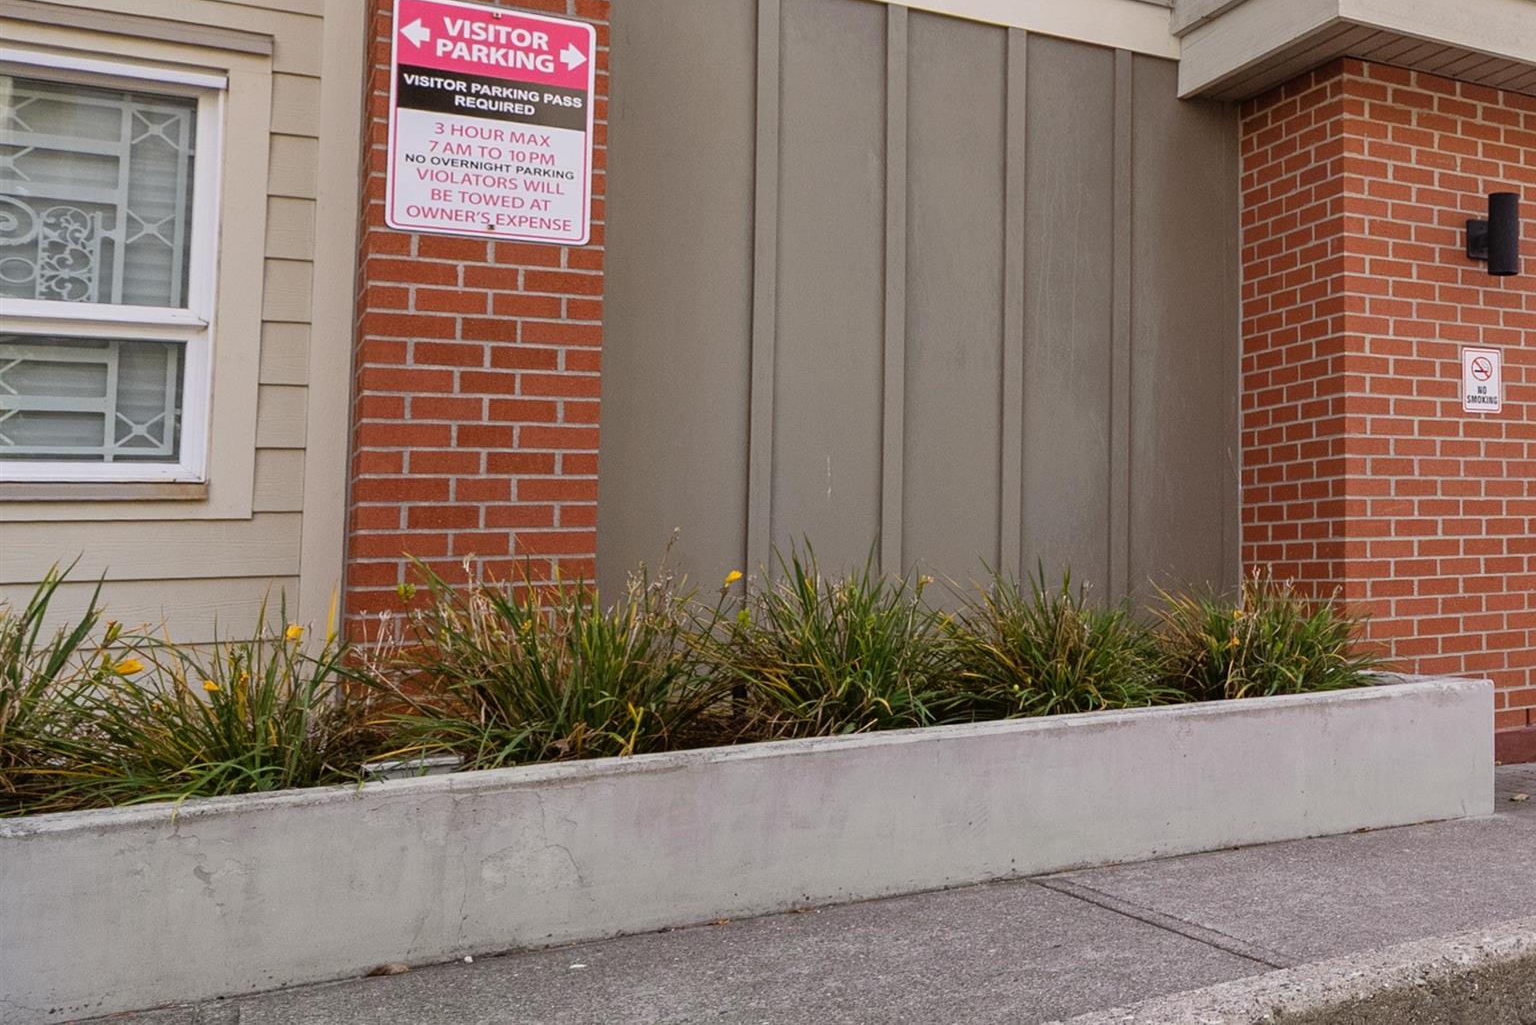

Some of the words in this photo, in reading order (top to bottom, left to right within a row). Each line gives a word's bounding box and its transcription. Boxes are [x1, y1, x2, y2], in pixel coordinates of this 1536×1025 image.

[443, 16, 549, 51] VISITOR
[436, 38, 555, 73] PARKING
[403, 73, 467, 93] VISITOR
[471, 84, 540, 102] PARKING
[543, 93, 583, 109] PASS
[454, 95, 536, 116] REQUIRED
[434, 121, 445, 135] 3
[451, 123, 504, 142] HOUR
[509, 131, 551, 148] MAX
[405, 153, 426, 164] NO
[430, 156, 512, 174] OVERNIGHT
[515, 166, 575, 180] PARKING
[429, 140, 438, 153] 7
[442, 142, 472, 157] AM
[478, 145, 503, 160] TO
[509, 150, 526, 163] 10
[529, 152, 556, 167] PM
[416, 167, 518, 190] VIOLATORS
[523, 180, 565, 195] WILL
[431, 188, 453, 202] BE
[458, 190, 525, 209] TOWED
[529, 198, 551, 212] AT
[406, 204, 491, 225] OWNER'S
[495, 213, 572, 232] EXPENSE
[1467, 395, 1497, 404] SMOKING
[1478, 386, 1487, 394] NO
